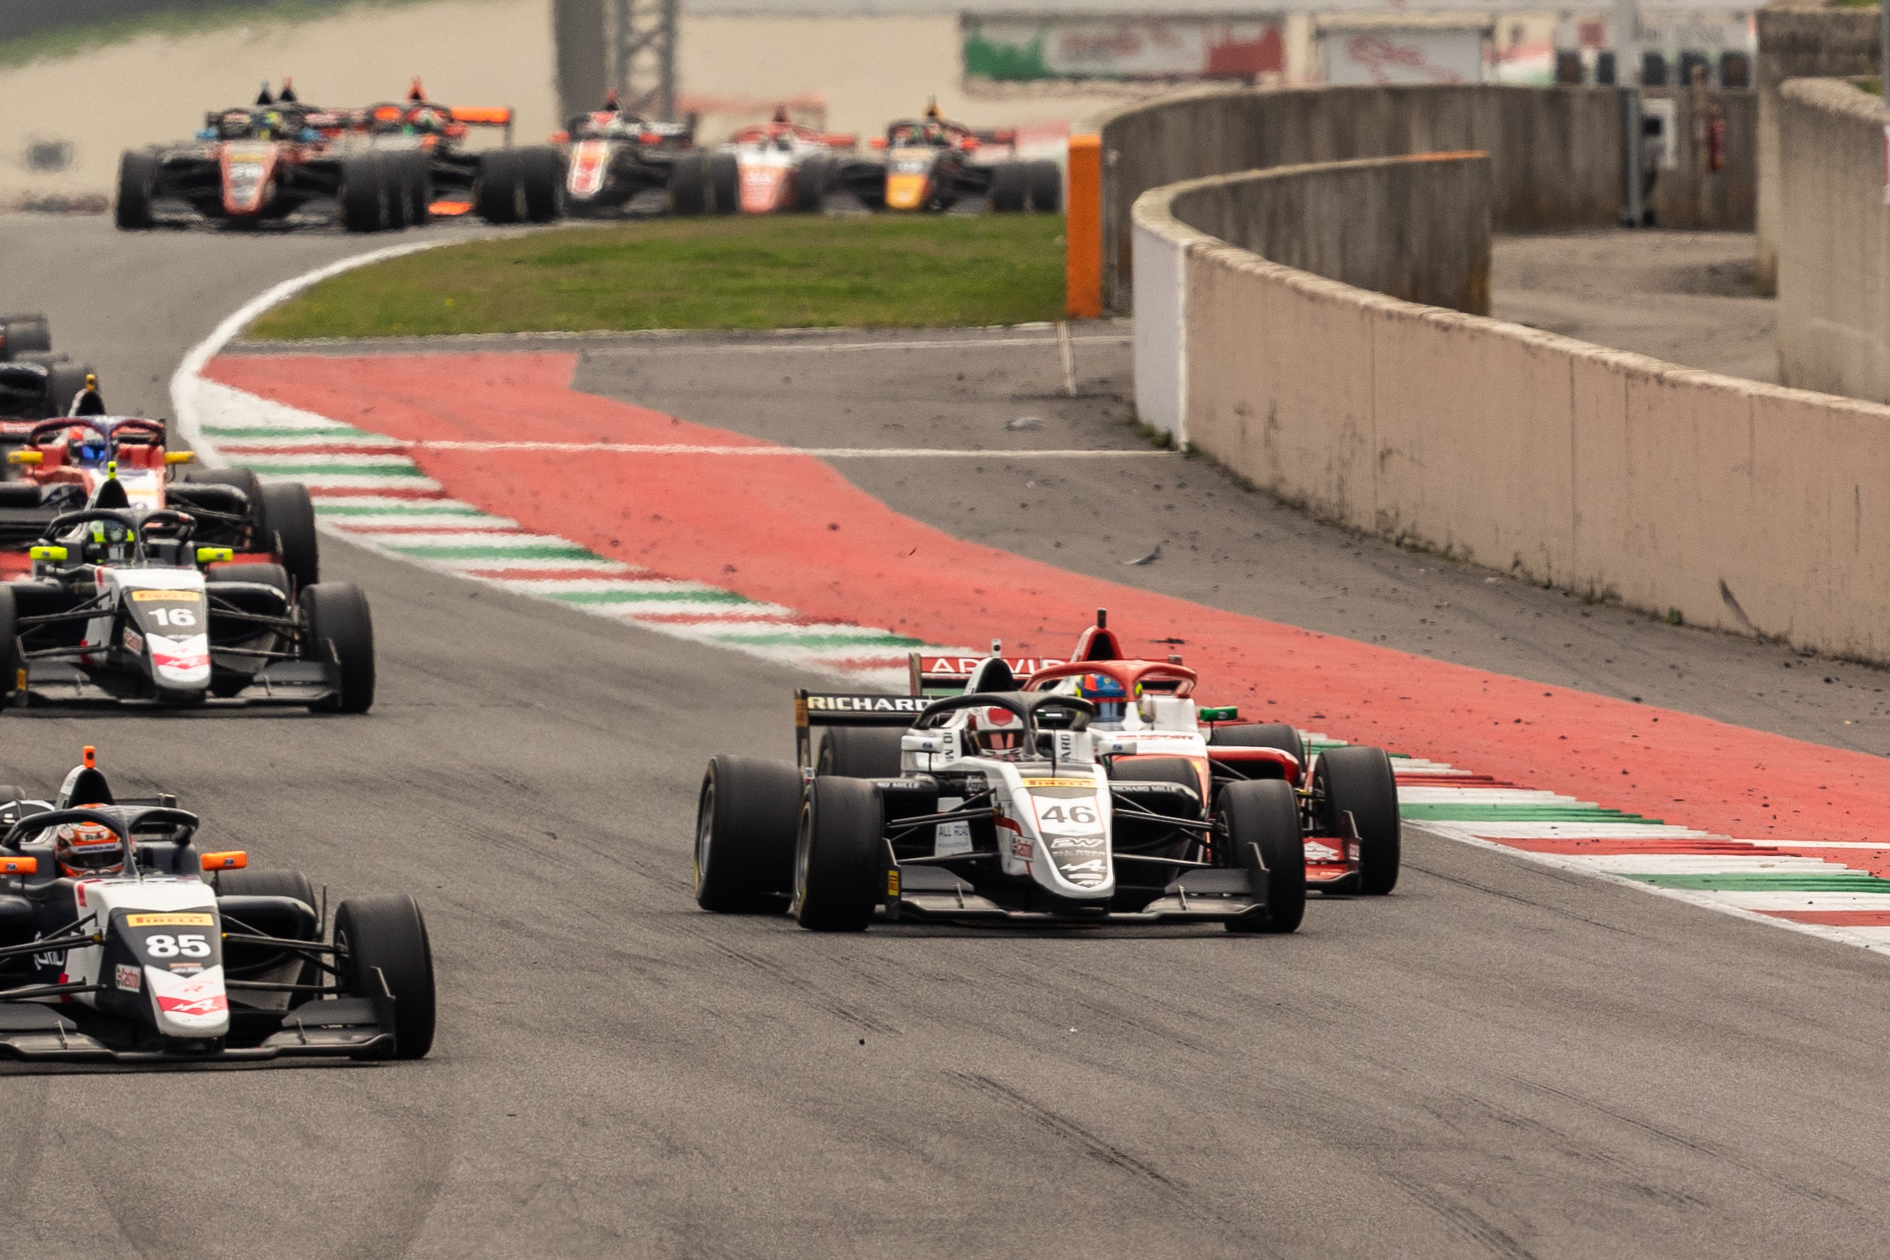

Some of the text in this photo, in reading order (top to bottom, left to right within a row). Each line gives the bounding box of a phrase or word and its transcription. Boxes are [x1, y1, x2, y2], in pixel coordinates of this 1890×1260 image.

[148, 607, 197, 627] 16
[807, 696, 934, 712] RICHARD
[1041, 805, 1096, 824] 46
[135, 915, 205, 924] PIRELLI
[145, 933, 212, 958] 85
